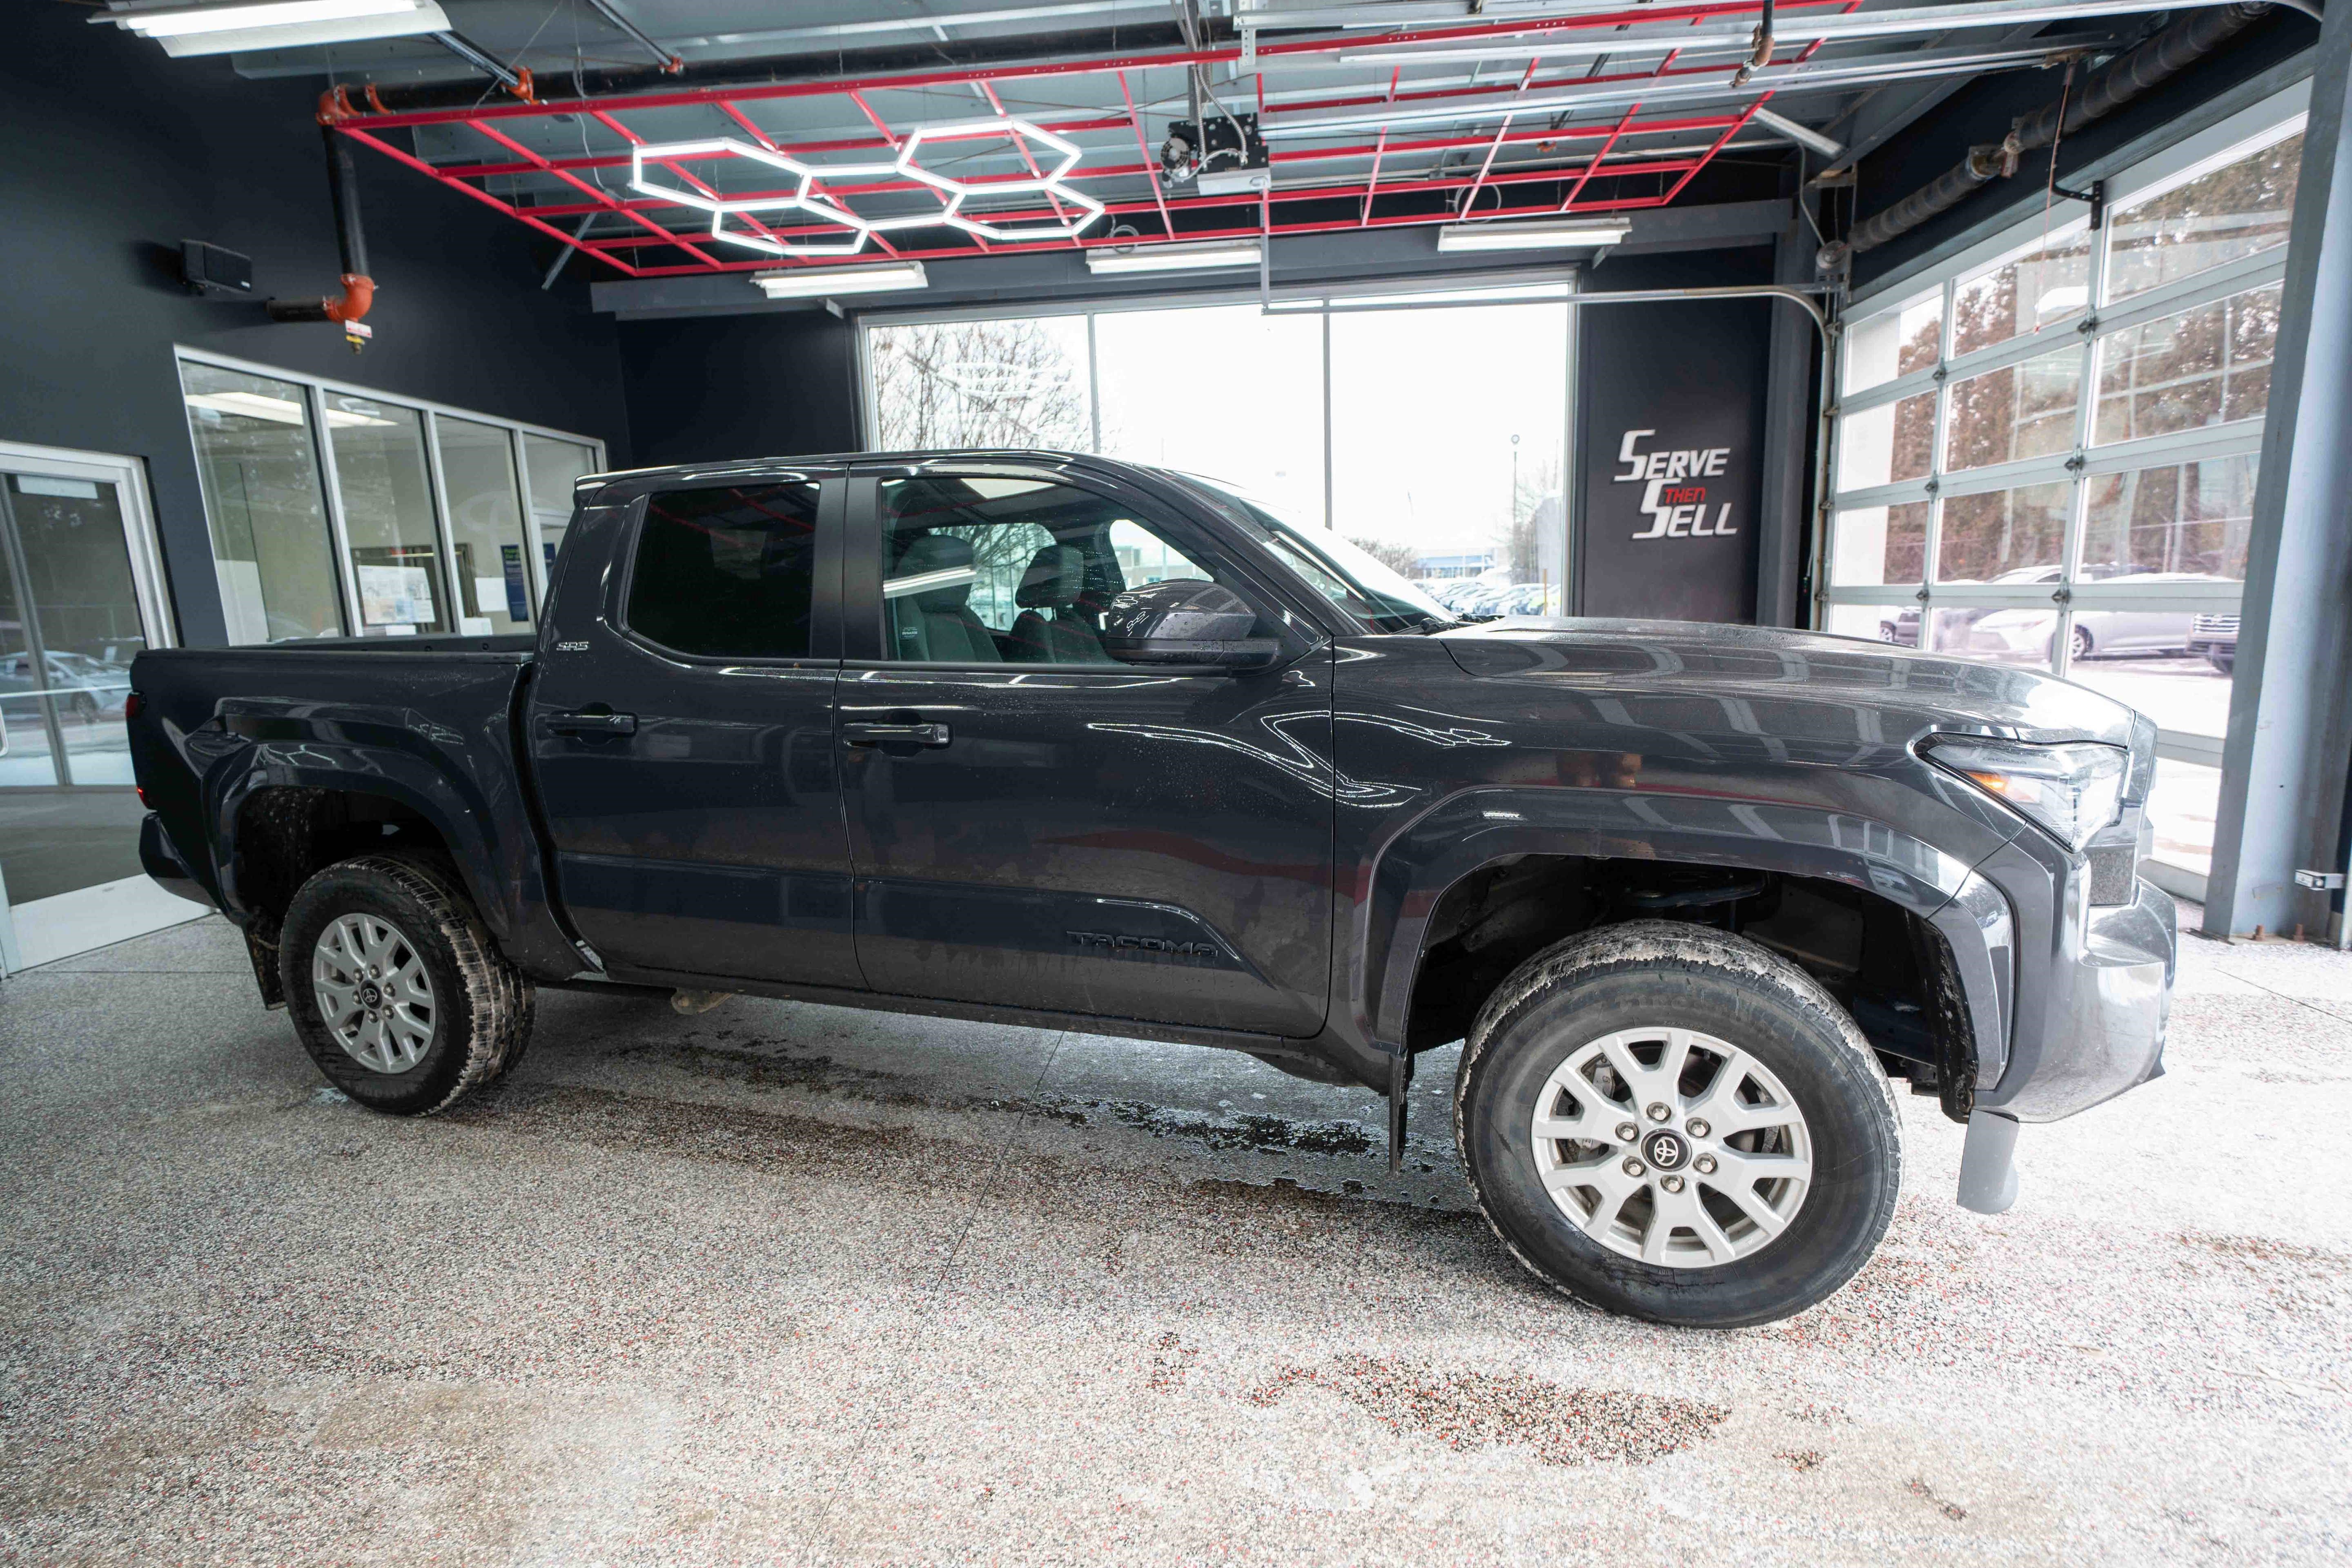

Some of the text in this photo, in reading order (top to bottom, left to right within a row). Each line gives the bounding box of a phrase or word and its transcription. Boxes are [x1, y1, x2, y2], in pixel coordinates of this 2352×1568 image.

[1614, 429, 1731, 481] SERVE
[1632, 477, 1738, 539] SELL
[1665, 487, 1706, 504] THEN
[556, 641, 588, 651] SR5
[1066, 930, 1218, 957] TACOMA
